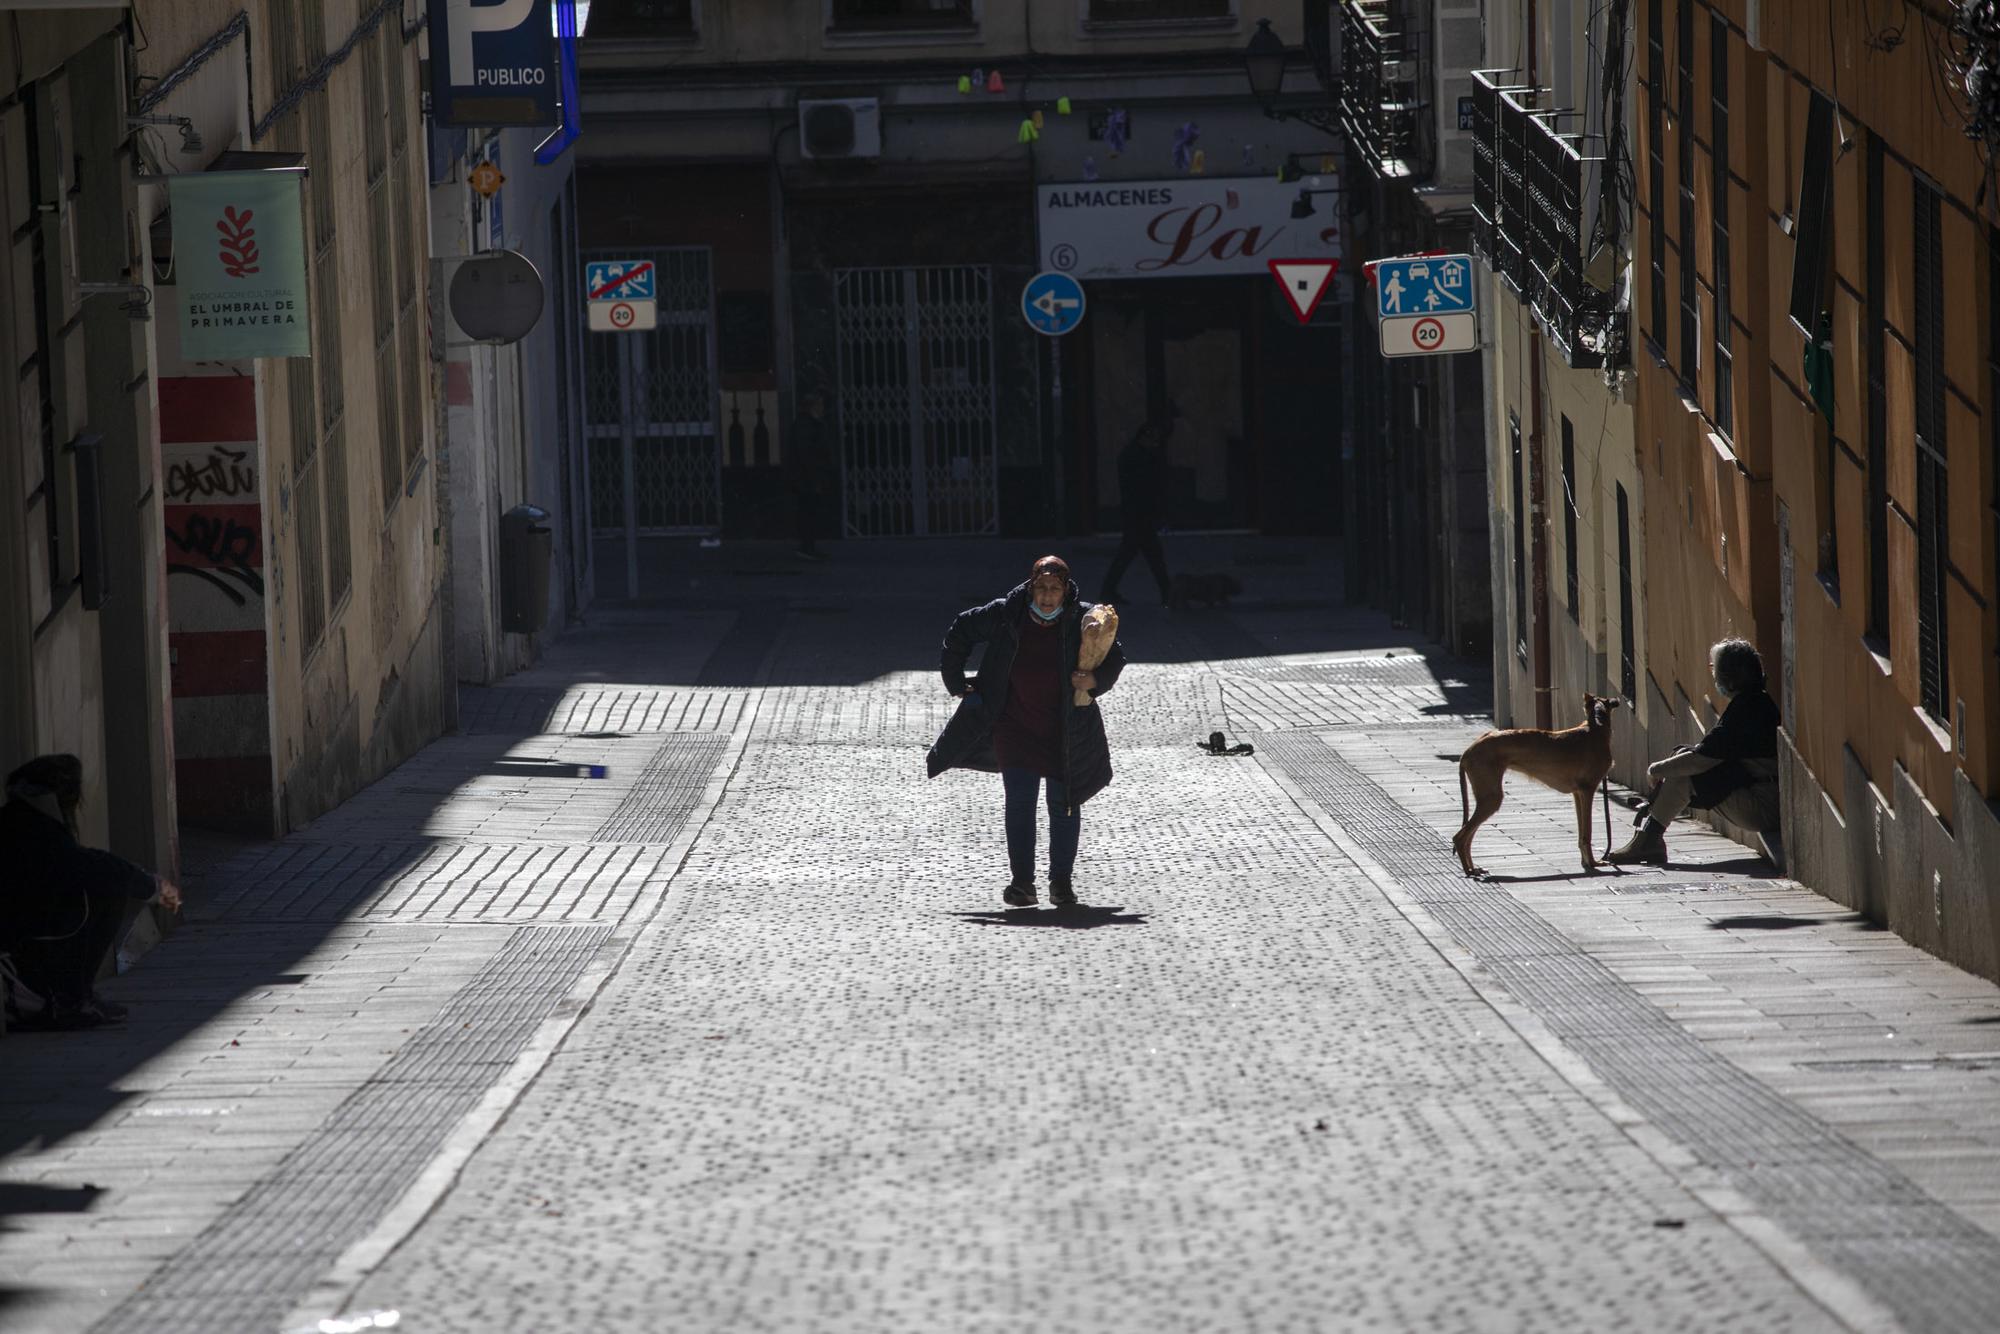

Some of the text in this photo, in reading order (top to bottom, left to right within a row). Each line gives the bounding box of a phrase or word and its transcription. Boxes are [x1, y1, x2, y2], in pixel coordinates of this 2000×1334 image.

[447, 0, 535, 86] P
[477, 67, 546, 86] PUBLICO
[479, 171, 496, 189] P
[1049, 188, 1173, 209] ALMACENES
[1135, 203, 1286, 271] La
[1057, 247, 1071, 267] 6
[190, 300, 295, 315] EL UMBRAL DE
[615, 311, 630, 320] 20
[191, 314, 296, 328] PRIMAVERA
[1419, 328, 1438, 340] 20
